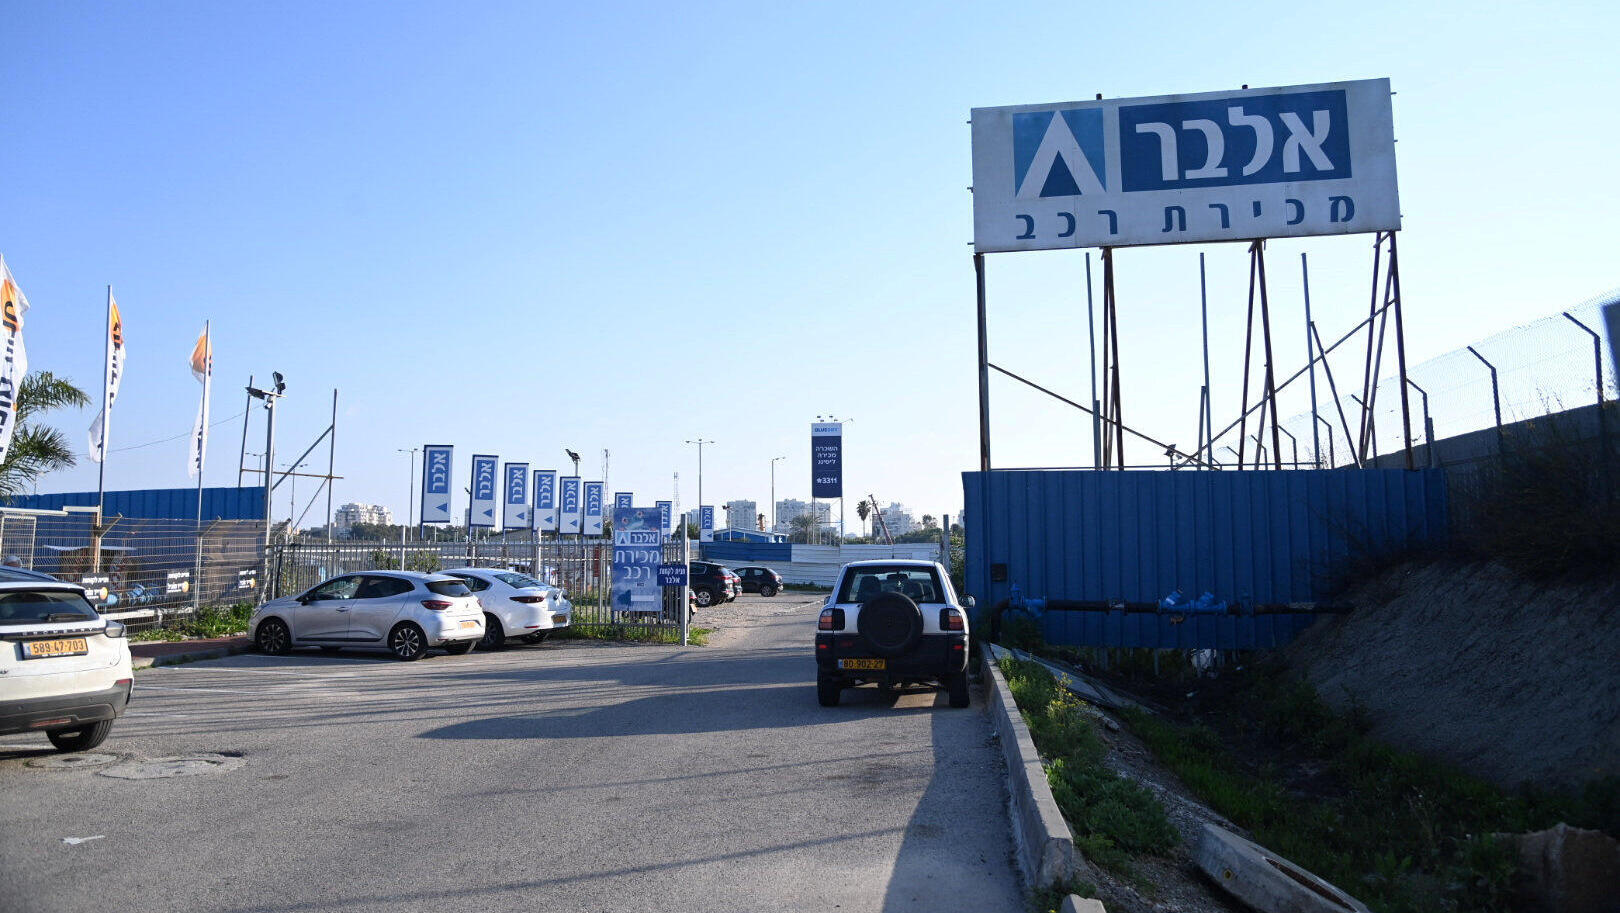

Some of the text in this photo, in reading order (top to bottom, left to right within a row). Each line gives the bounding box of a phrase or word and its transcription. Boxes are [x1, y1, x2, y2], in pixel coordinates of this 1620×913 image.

[1135, 106, 1335, 181] אלבר
[1015, 195, 1355, 240] מכירת רכב
[431, 453, 447, 491] אלבר
[478, 462, 493, 498] אלבר
[511, 469, 525, 502] אלבר
[539, 476, 552, 507] אלבר
[565, 482, 576, 511] אלבר
[589, 486, 599, 514] אלבר
[631, 533, 656, 543] אלבר
[614, 550, 660, 564] מכירת
[623, 566, 651, 579] רכב
[665, 576, 681, 584] אלבר
